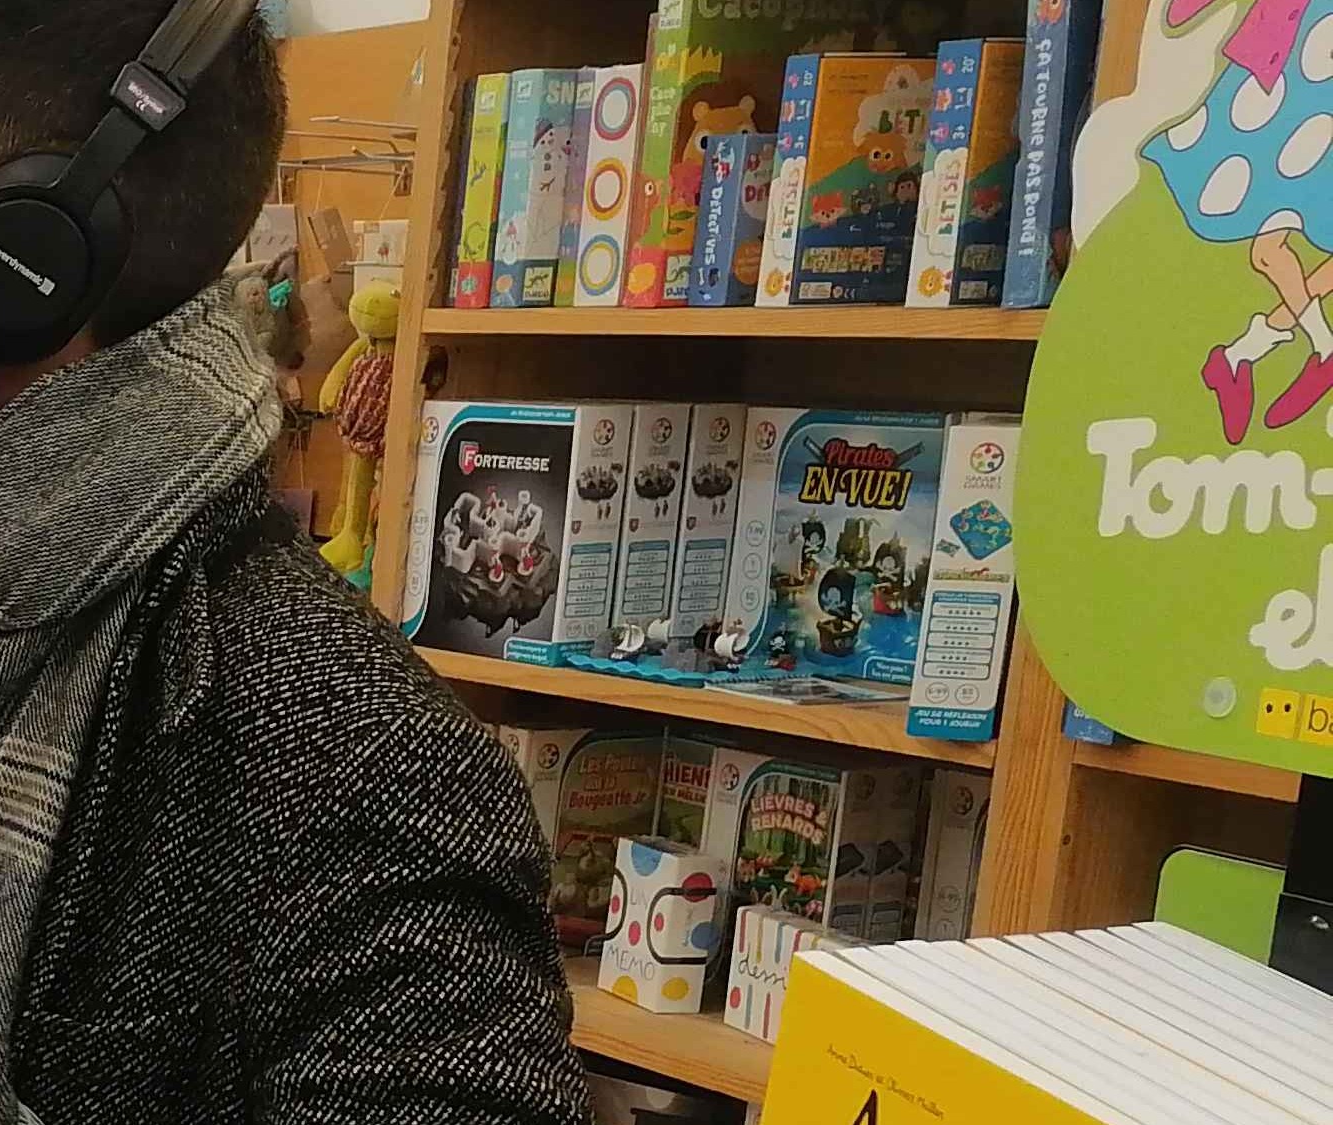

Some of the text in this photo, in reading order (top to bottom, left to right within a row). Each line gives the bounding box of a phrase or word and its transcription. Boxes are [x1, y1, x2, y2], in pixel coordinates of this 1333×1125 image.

[463, 446, 549, 473] FORTERESSE
[826, 438, 895, 468] Pirates
[801, 466, 837, 503] EN
[750, 815, 826, 846] RENARDS
